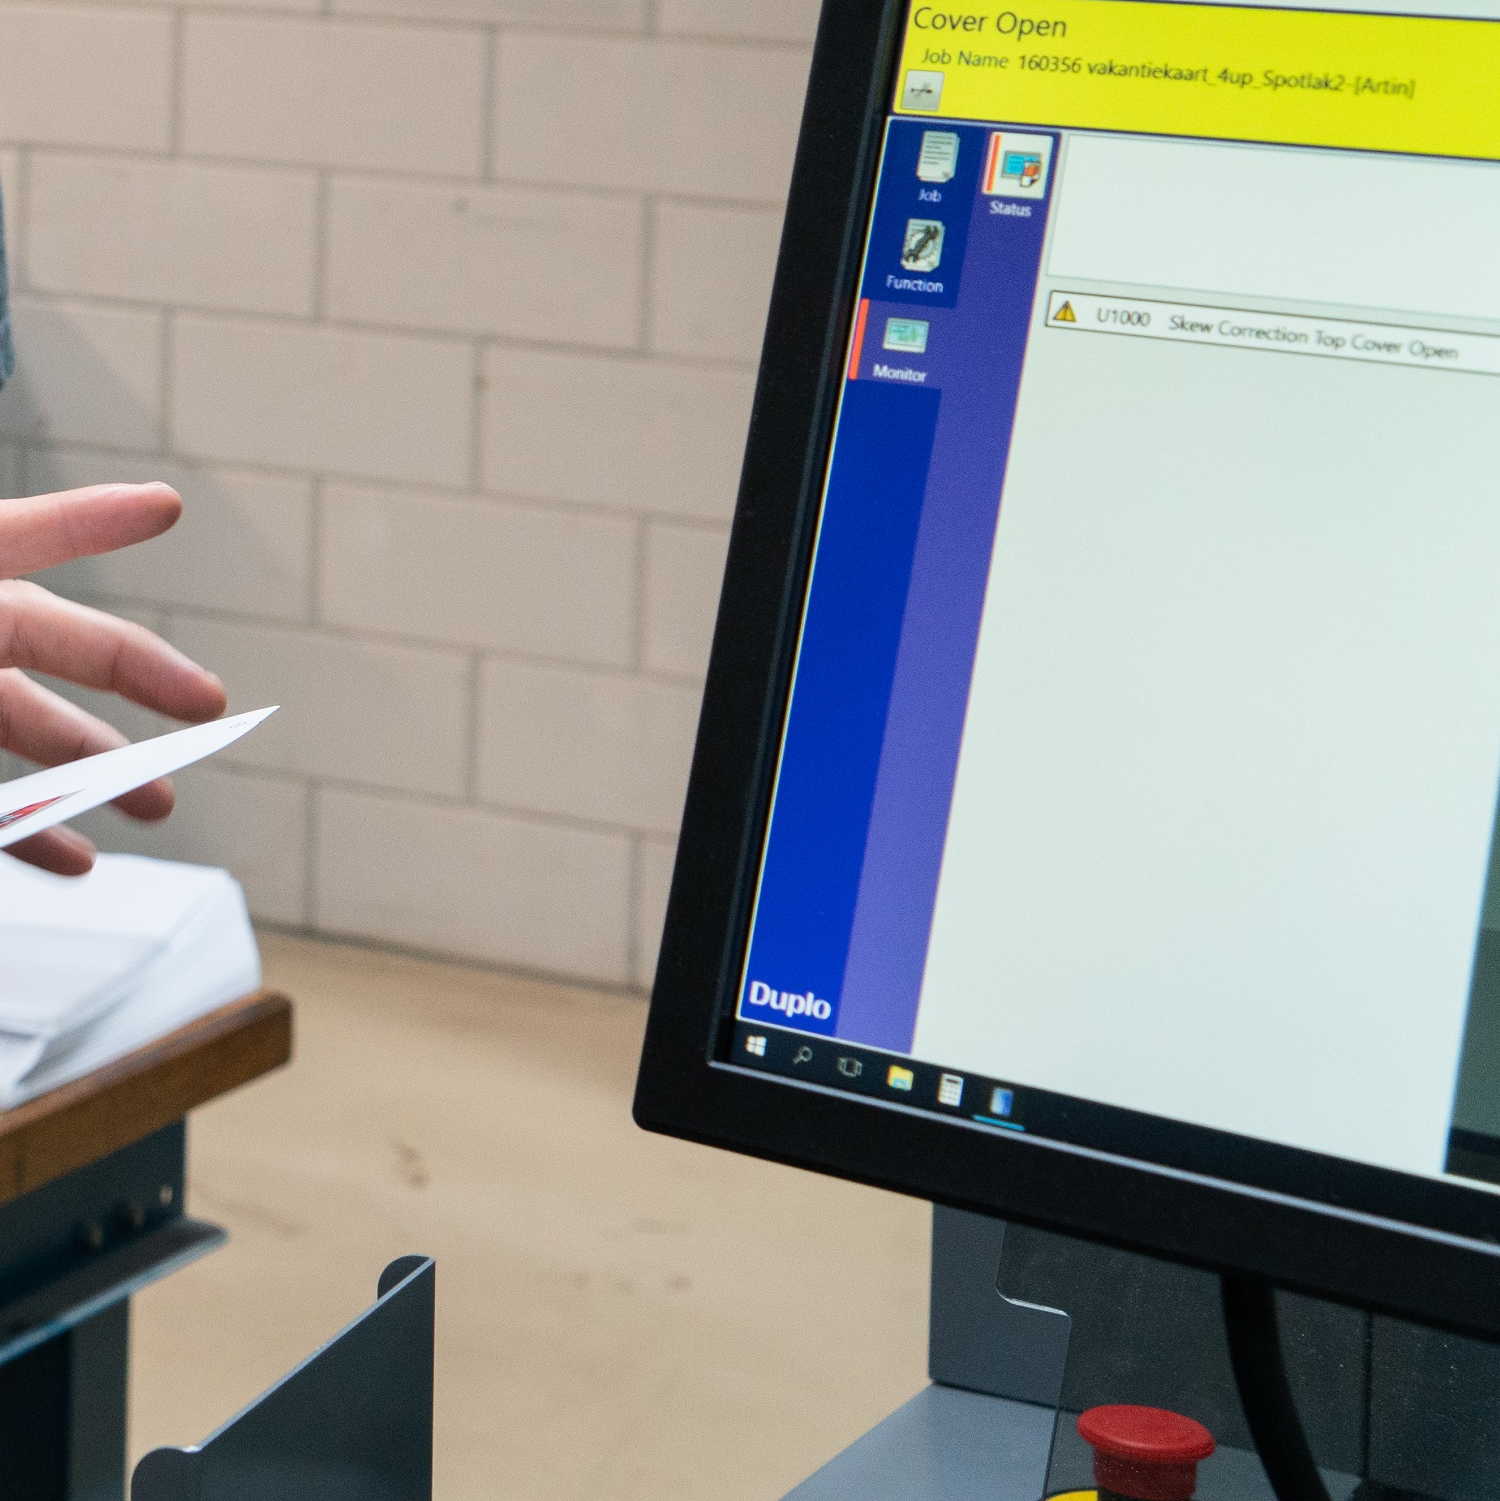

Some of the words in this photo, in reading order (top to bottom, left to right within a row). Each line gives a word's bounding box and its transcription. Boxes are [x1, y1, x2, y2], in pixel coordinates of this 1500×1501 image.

[914, 6, 989, 33] Cover
[996, 11, 1067, 41] Open
[921, 49, 952, 66] Job
[958, 51, 1009, 69] Name
[1019, 55, 1082, 74] 160356
[917, 189, 942, 203] Job
[989, 201, 1032, 218] Status
[886, 275, 944, 293] Function
[1096, 307, 1152, 328] U1000
[1169, 314, 1213, 335] Skew
[1218, 319, 1309, 345] Correction
[1315, 329, 1347, 350] Top
[1351, 333, 1402, 355] Cover
[1408, 340, 1460, 361] Open
[872, 365, 928, 383] Monitor
[749, 980, 832, 1020] Duplo
